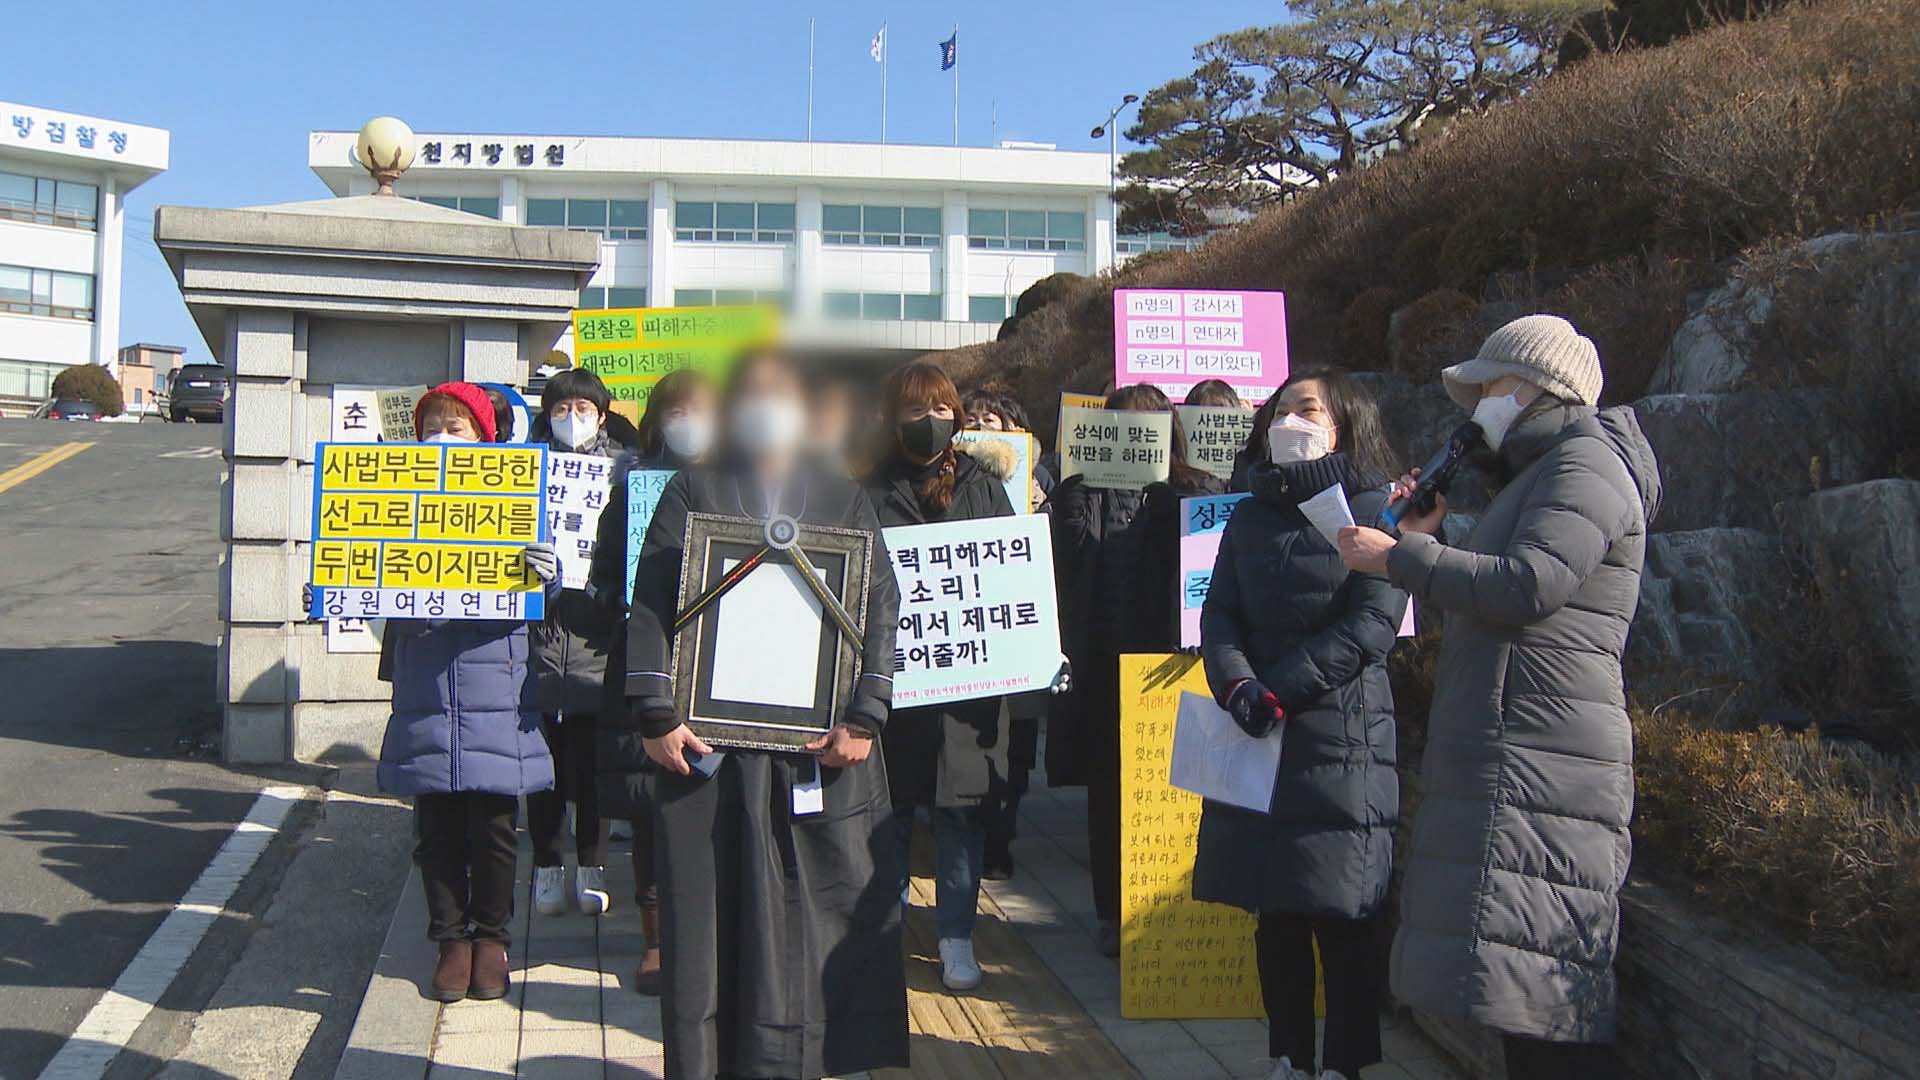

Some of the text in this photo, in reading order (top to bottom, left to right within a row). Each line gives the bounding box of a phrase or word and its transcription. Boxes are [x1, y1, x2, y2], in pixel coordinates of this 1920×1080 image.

[12, 114, 128, 154] 방검찰청
[421, 141, 565, 165] 천지방법원
[1135, 298, 1236, 313] n명의 감시자
[579, 318, 634, 340] 검찰은
[1135, 325, 1237, 341] n명의 연대자
[581, 353, 635, 374] 재판이
[1136, 353, 1181, 369] 우리가
[343, 402, 368, 430] 춘
[1198, 413, 1255, 429] 사법부는
[1073, 424, 1160, 443] 상식에 맞는
[1069, 445, 1163, 464] 재판을 하라!!
[324, 451, 540, 487] 사법부는 부당한
[323, 499, 537, 536] 선고로 피해자를
[928, 536, 1032, 570] 피해자의
[324, 590, 519, 617] 강원여성연대
[961, 602, 1039, 634] 제대로
